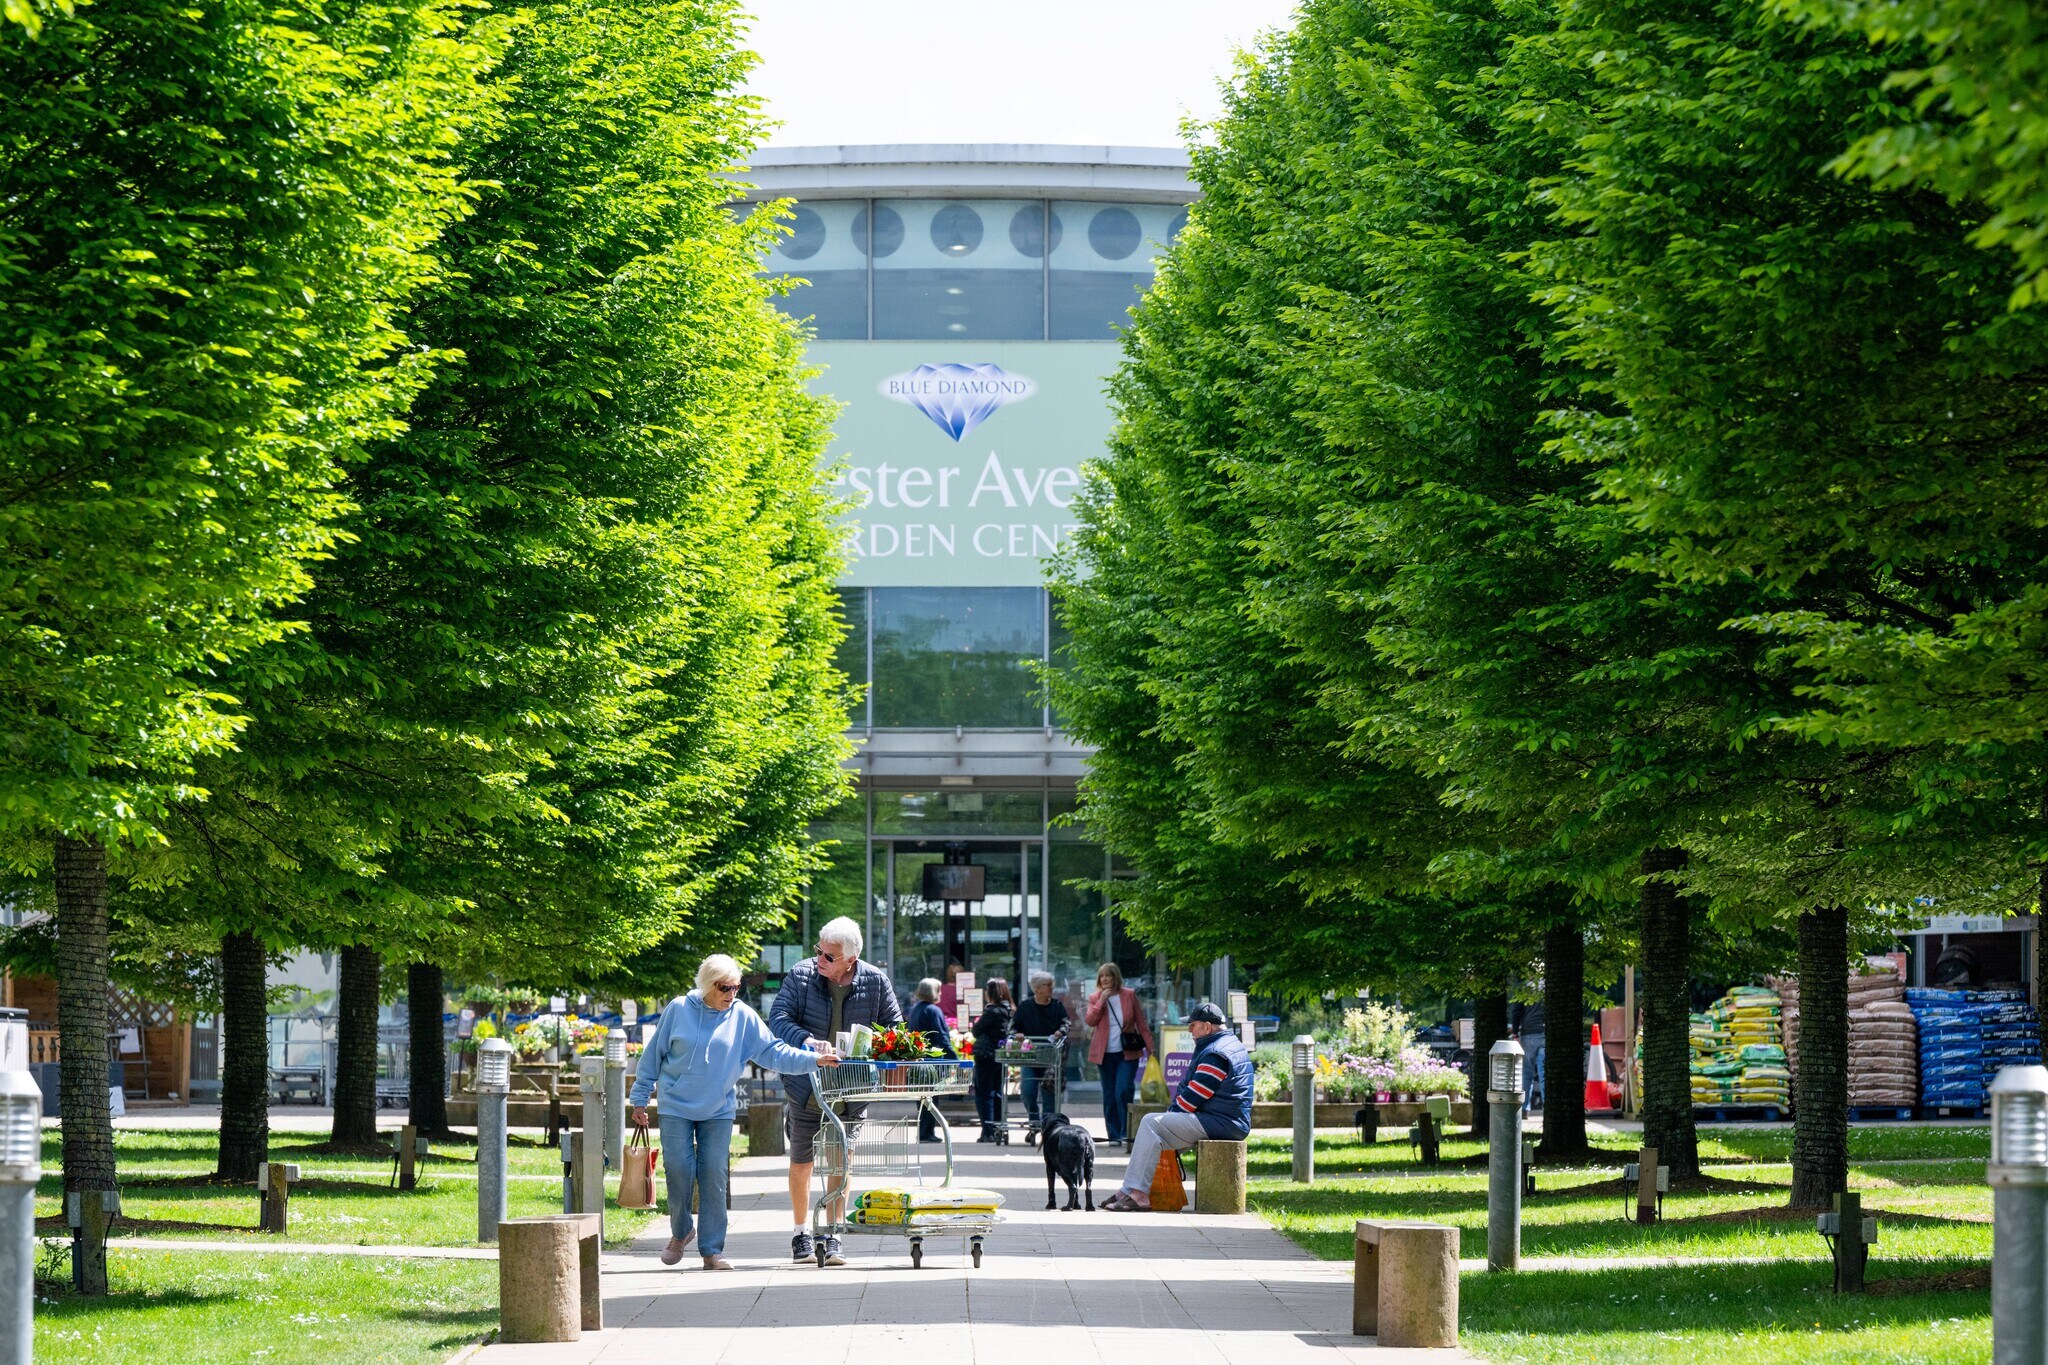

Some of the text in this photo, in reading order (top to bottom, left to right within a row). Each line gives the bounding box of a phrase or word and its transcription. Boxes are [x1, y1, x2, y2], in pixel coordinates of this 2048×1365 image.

[889, 380, 1026, 395] BLUE DIAMOND
[827, 449, 1080, 508] ster Ave
[972, 523, 1097, 557] CENT
[1168, 1059, 1192, 1067] BOTTL
[1167, 1069, 1182, 1077] GAS
